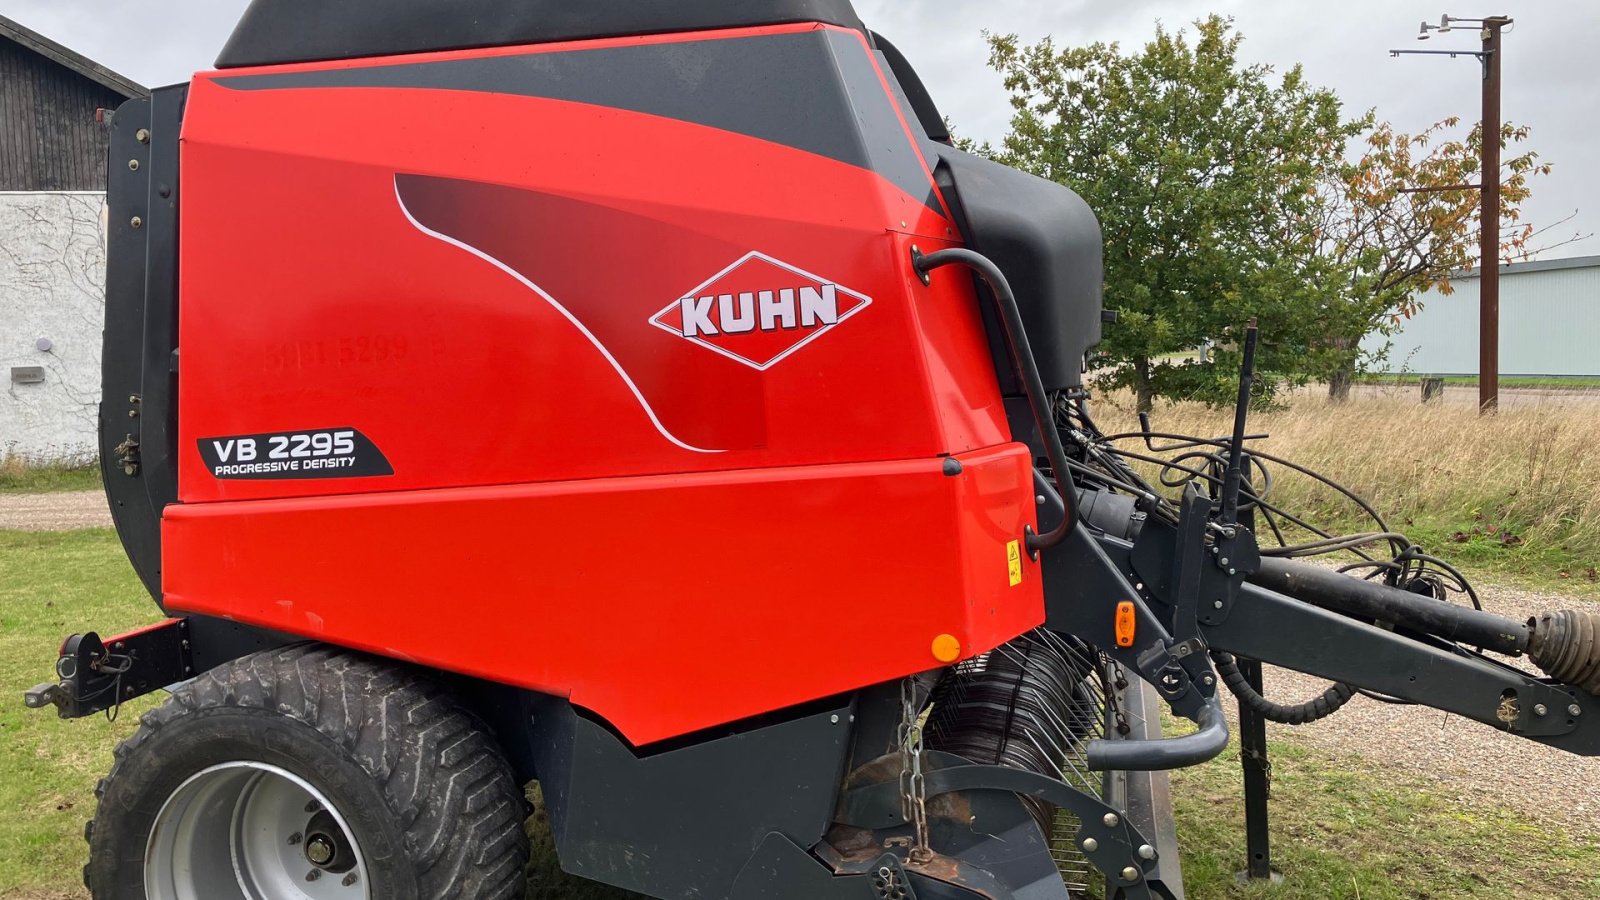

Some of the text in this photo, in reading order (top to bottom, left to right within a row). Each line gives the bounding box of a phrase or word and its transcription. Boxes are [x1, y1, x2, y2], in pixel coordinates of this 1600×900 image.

[680, 284, 838, 337] KUHN
[213, 431, 355, 463] VB 2295
[215, 456, 356, 476] PROGRESSIVE DENSITY
